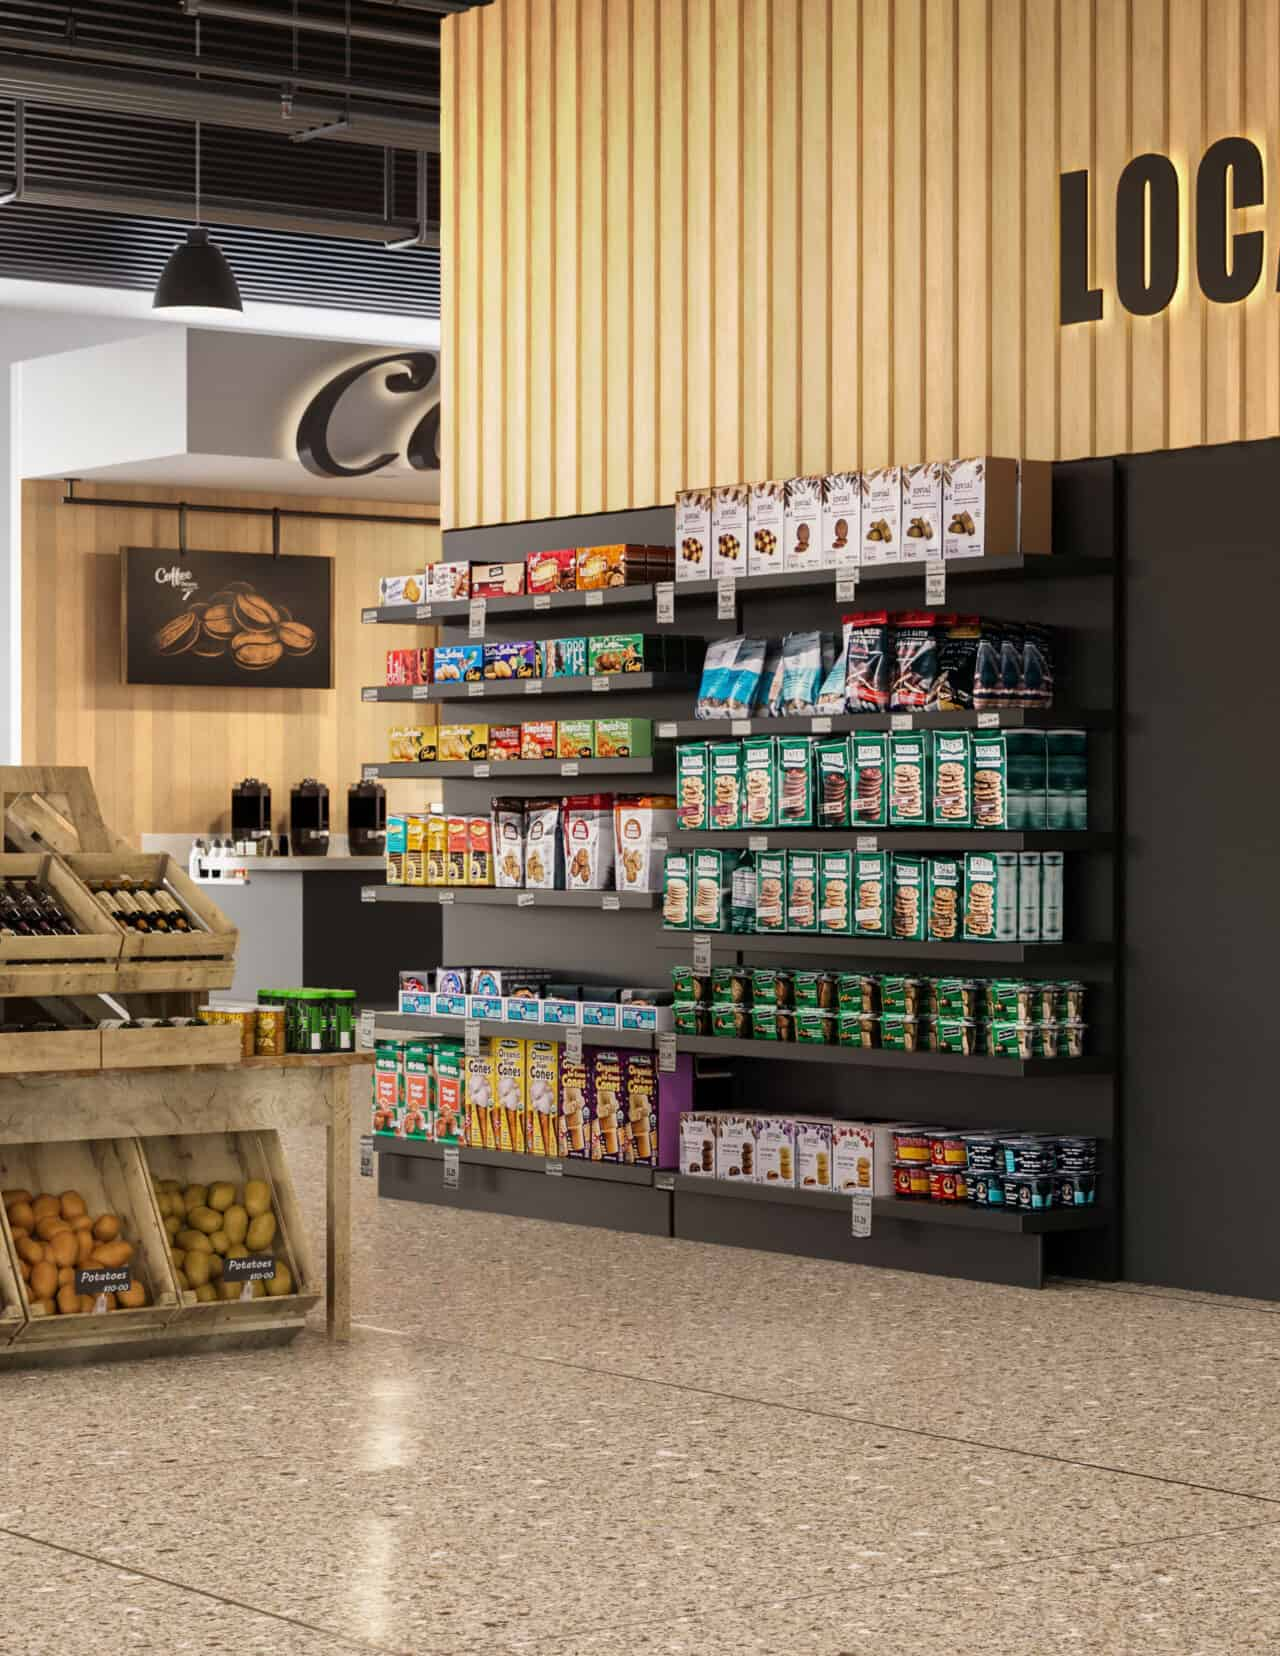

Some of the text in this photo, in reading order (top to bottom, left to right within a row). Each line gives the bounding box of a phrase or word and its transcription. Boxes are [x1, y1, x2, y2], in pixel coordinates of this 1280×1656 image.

[530, 1065, 554, 1080] Cones
[228, 1259, 273, 1271] Potatoes
[80, 1270, 128, 1283] Potatoes
